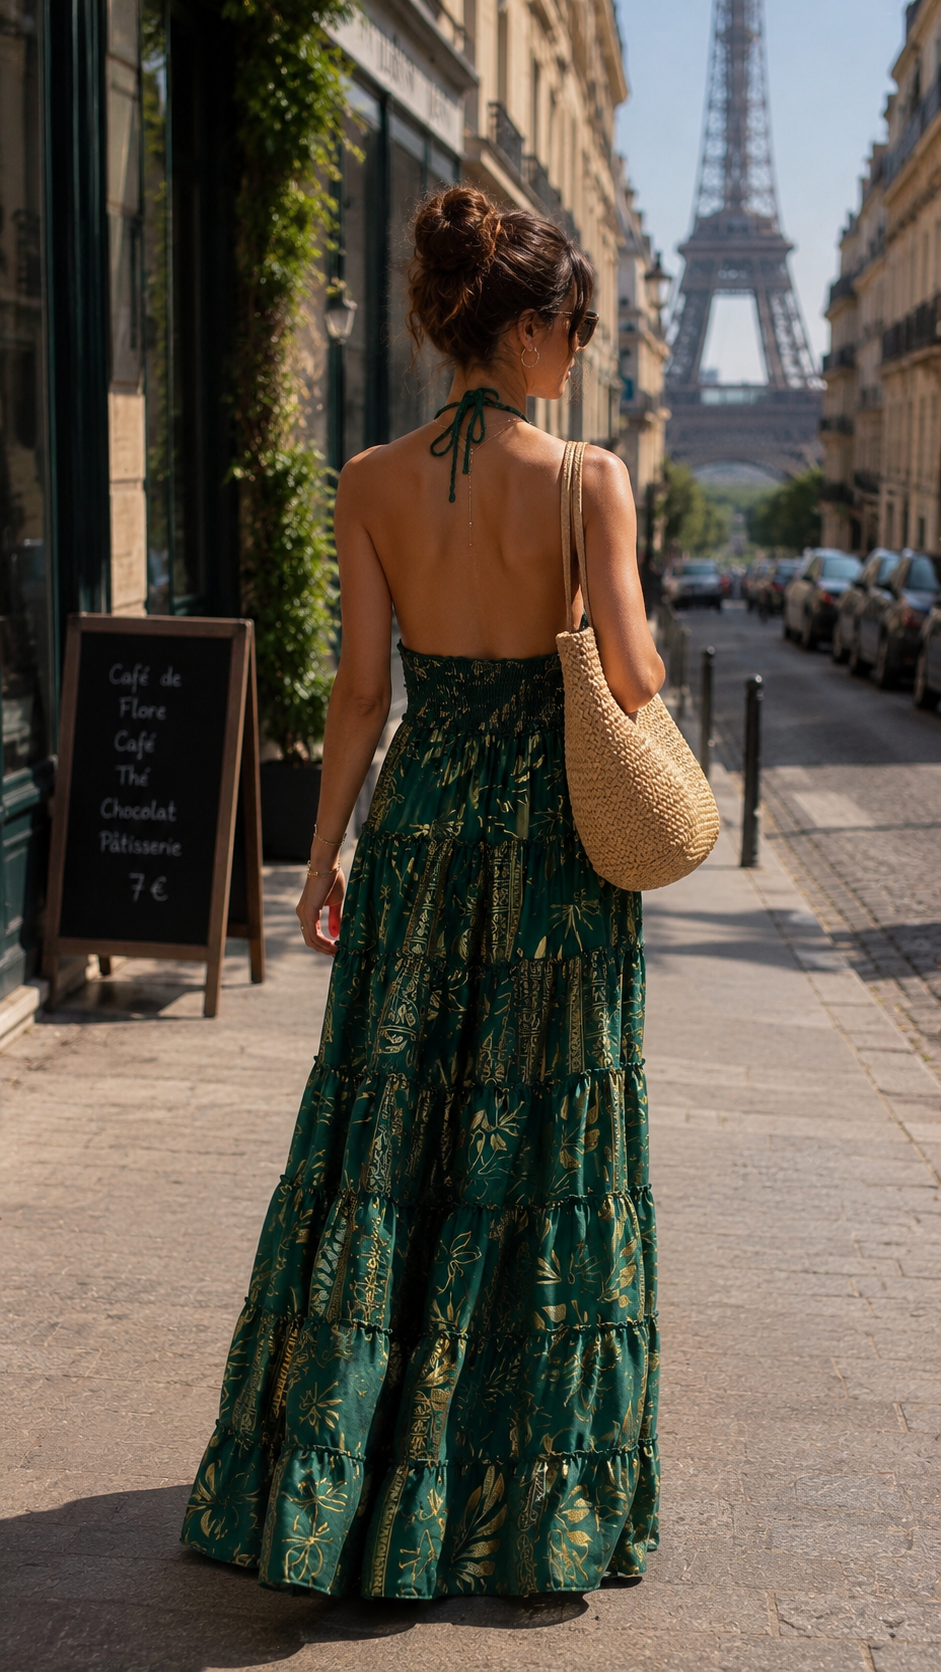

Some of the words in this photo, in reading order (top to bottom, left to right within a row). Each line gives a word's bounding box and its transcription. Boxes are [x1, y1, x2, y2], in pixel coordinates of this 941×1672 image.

[109, 663, 149, 692] Café
[160, 667, 181, 687] de
[120, 697, 166, 720] Flore
[114, 730, 156, 760] Café
[116, 765, 150, 786] Thé
[100, 798, 176, 822] Chocolat
[100, 831, 182, 857] Pâtisserie
